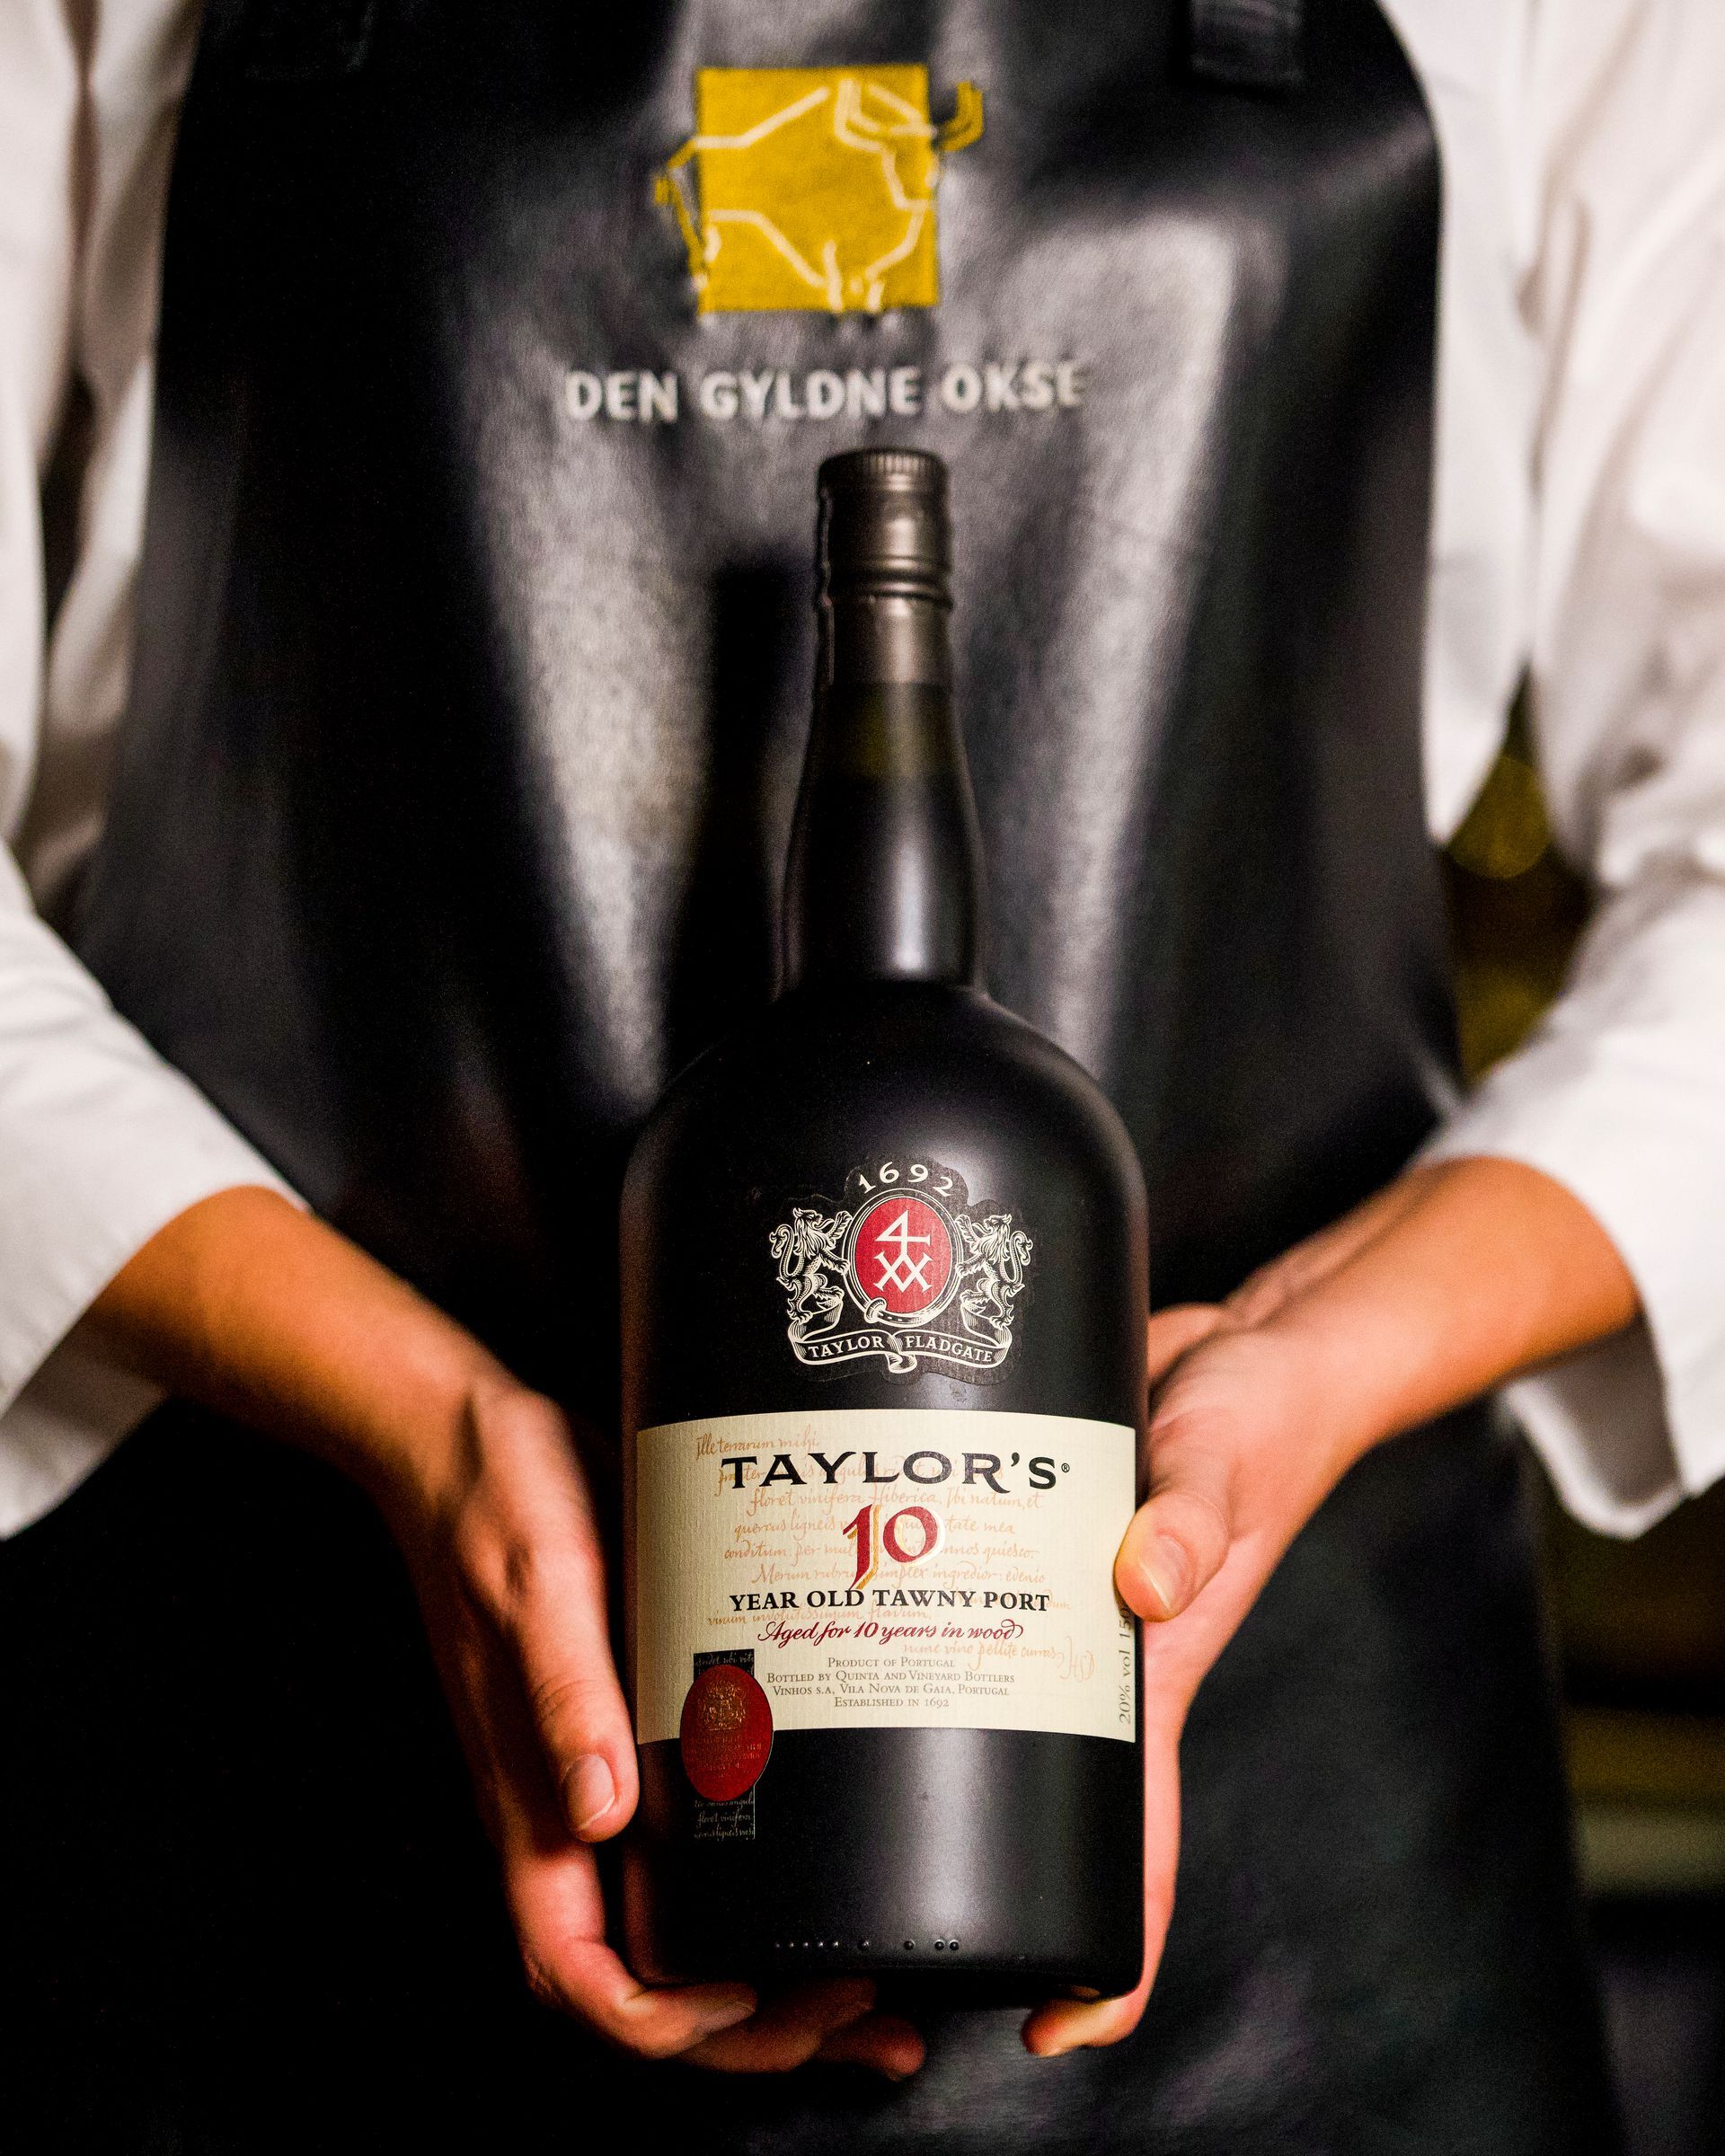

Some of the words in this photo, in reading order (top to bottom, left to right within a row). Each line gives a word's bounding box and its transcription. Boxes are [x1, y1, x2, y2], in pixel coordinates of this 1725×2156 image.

[564, 369, 678, 423] DEN
[699, 366, 923, 421] GYLDNE
[941, 360, 1086, 412] OKSE
[859, 1162, 954, 1197] 1692
[808, 1335, 886, 1359] TAYLOR
[905, 1335, 994, 1363] FLADGATE
[843, 1503, 943, 1590] 10
[729, 1590, 801, 1613] YEAR
[806, 1588, 865, 1608] OLD
[871, 1588, 977, 1608] TAWNY
[983, 1591, 1050, 1613] PORT
[757, 1619, 821, 1649] Aged
[812, 1620, 852, 1647] for
[854, 1621, 880, 1639] 10
[878, 1622, 937, 1646] years
[941, 1621, 965, 1639] in
[967, 1618, 1024, 1640] wood
[766, 1672, 815, 1683] BOTTLED
[818, 1673, 832, 1682] BY
[836, 1670, 880, 1683] QUINTA
[884, 1671, 907, 1681] AND
[908, 1670, 961, 1682] VINEYARD
[964, 1671, 1015, 1683] BOTTLERS
[827, 1657, 880, 1668] PRODUCT
[883, 1659, 898, 1667] OF
[900, 1657, 956, 1668] PORTUGAL
[1118, 1648, 1132, 1678] vol
[772, 1685, 813, 1696] VINHOS
[839, 1683, 864, 1694] VILA
[868, 1683, 901, 1694] NOVA
[905, 1685, 920, 1694] DE
[958, 1683, 1011, 1696] PORTUGAL
[833, 1696, 904, 1708] ESTABLISHED
[907, 1698, 920, 1707] IN
[924, 1696, 950, 1710] 1692
[1118, 1684, 1132, 1725] 20%
